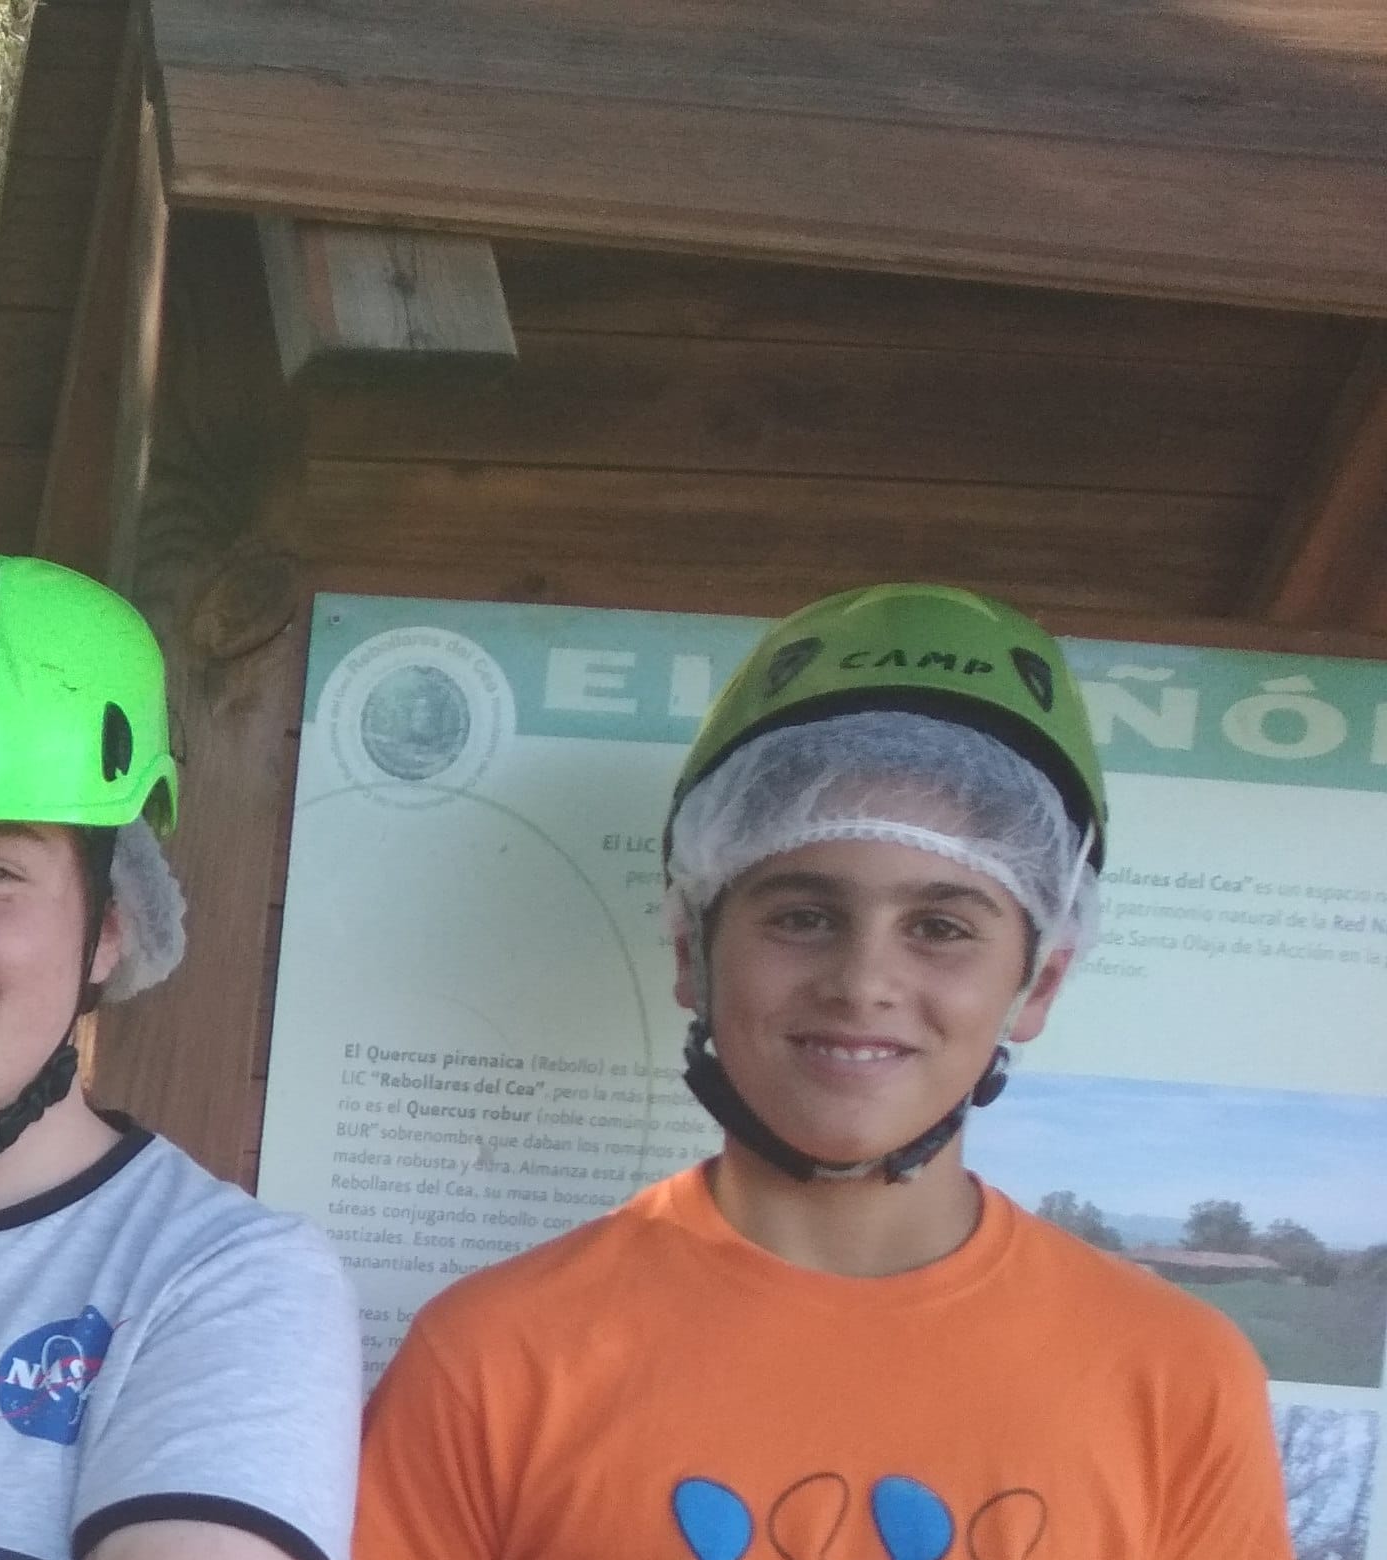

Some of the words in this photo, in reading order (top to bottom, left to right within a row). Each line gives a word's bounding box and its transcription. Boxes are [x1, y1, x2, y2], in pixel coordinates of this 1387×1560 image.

[839, 648, 995, 674] CAMP
[1174, 870, 1204, 889] del
[344, 1043, 361, 1059] El
[366, 1045, 437, 1064] Quercus
[442, 1053, 525, 1070] pirenaica
[341, 1069, 367, 1086] LIC
[473, 1076, 501, 1095] del
[365, 1101, 382, 1113] es
[387, 1098, 401, 1113] el
[406, 1100, 476, 1119] Quercus
[482, 1105, 533, 1122] robur
[380, 1124, 484, 1145] sobrenombre
[487, 1135, 519, 1152] que
[522, 1134, 571, 1151] daban
[333, 1149, 392, 1164] madera
[395, 1154, 456, 1170] robusta
[460, 1159, 469, 1176] y
[519, 1160, 588, 1178] Almanza
[330, 1173, 412, 1194] Rebollares
[416, 1178, 440, 1196] del
[482, 1187, 501, 1199] su
[506, 1188, 548, 1202] masa
[328, 1199, 377, 1217] táreas
[382, 1205, 476, 1226] conjugando
[482, 1209, 539, 1226] rebollo
[543, 1217, 572, 1229] con
[413, 1232, 456, 1248] Estos
[461, 1236, 521, 1253] montes
[358, 1307, 389, 1322] reas
